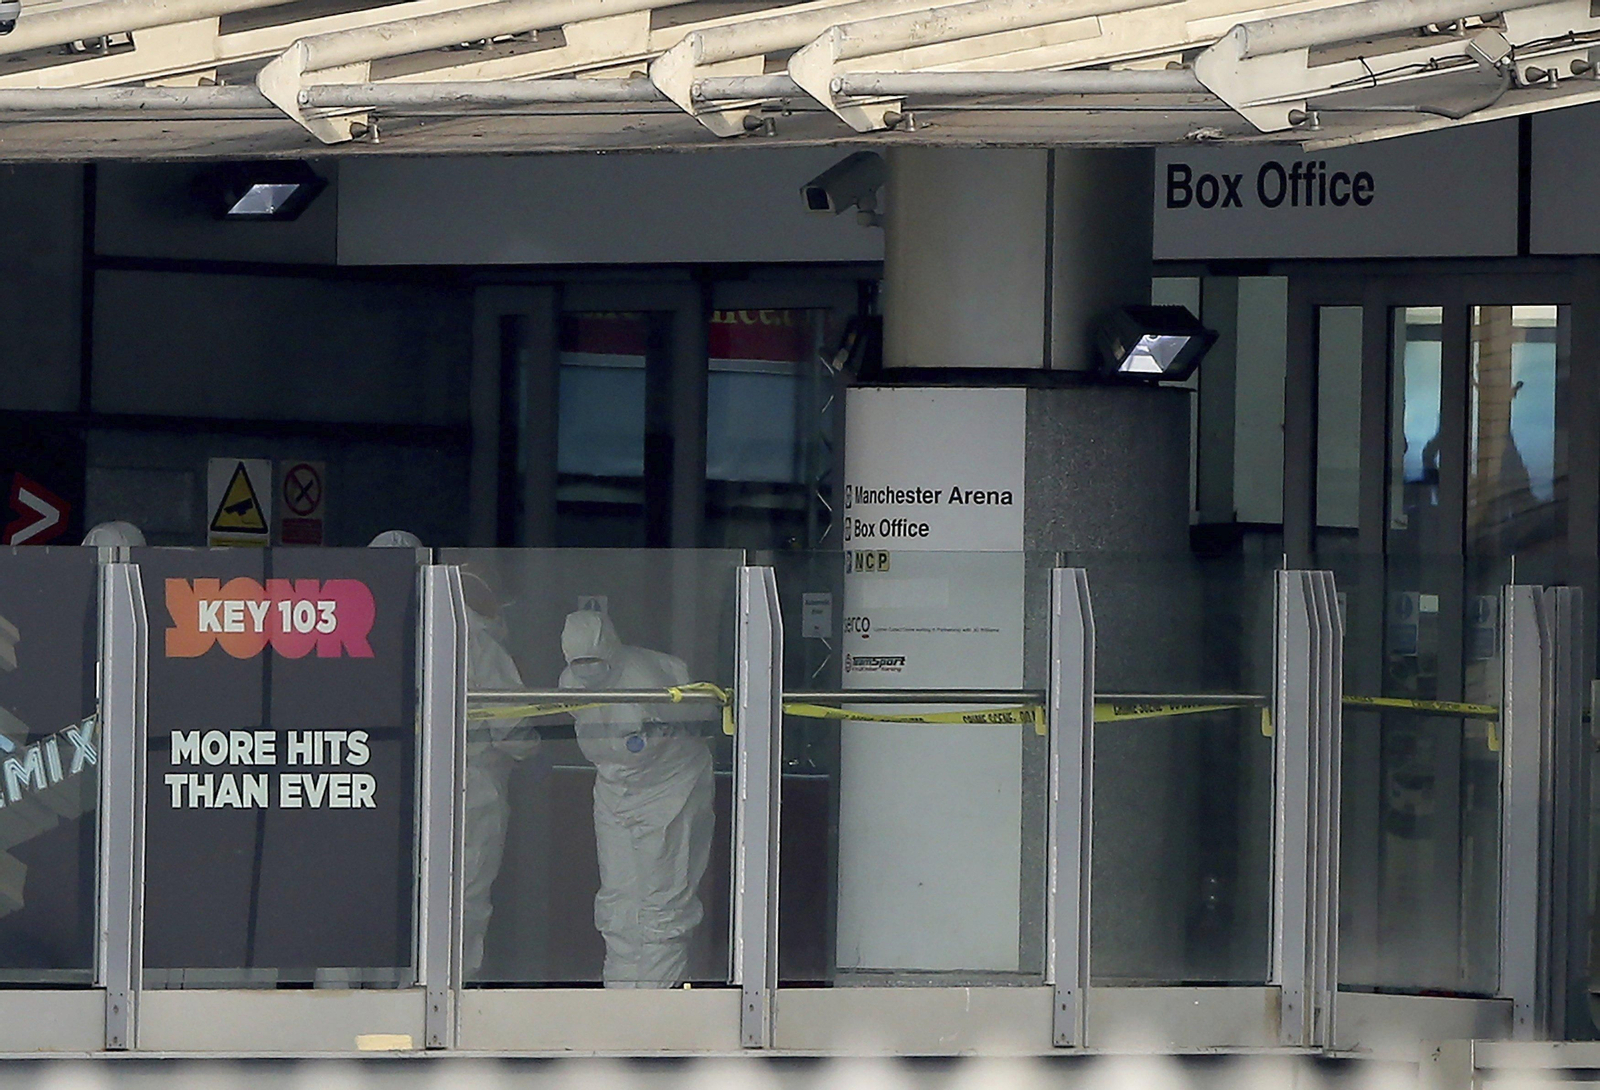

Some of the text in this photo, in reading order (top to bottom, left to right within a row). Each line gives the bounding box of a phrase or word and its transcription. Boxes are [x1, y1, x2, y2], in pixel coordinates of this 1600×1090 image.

[1166, 160, 1375, 209] Box Office
[855, 486, 1013, 505] Manchester Arena
[854, 518, 930, 538] Box Office
[855, 552, 889, 571] NCP
[199, 600, 337, 634] KEY 103
[170, 730, 371, 766] MORE HITS
[164, 773, 377, 809] THAN EVER
